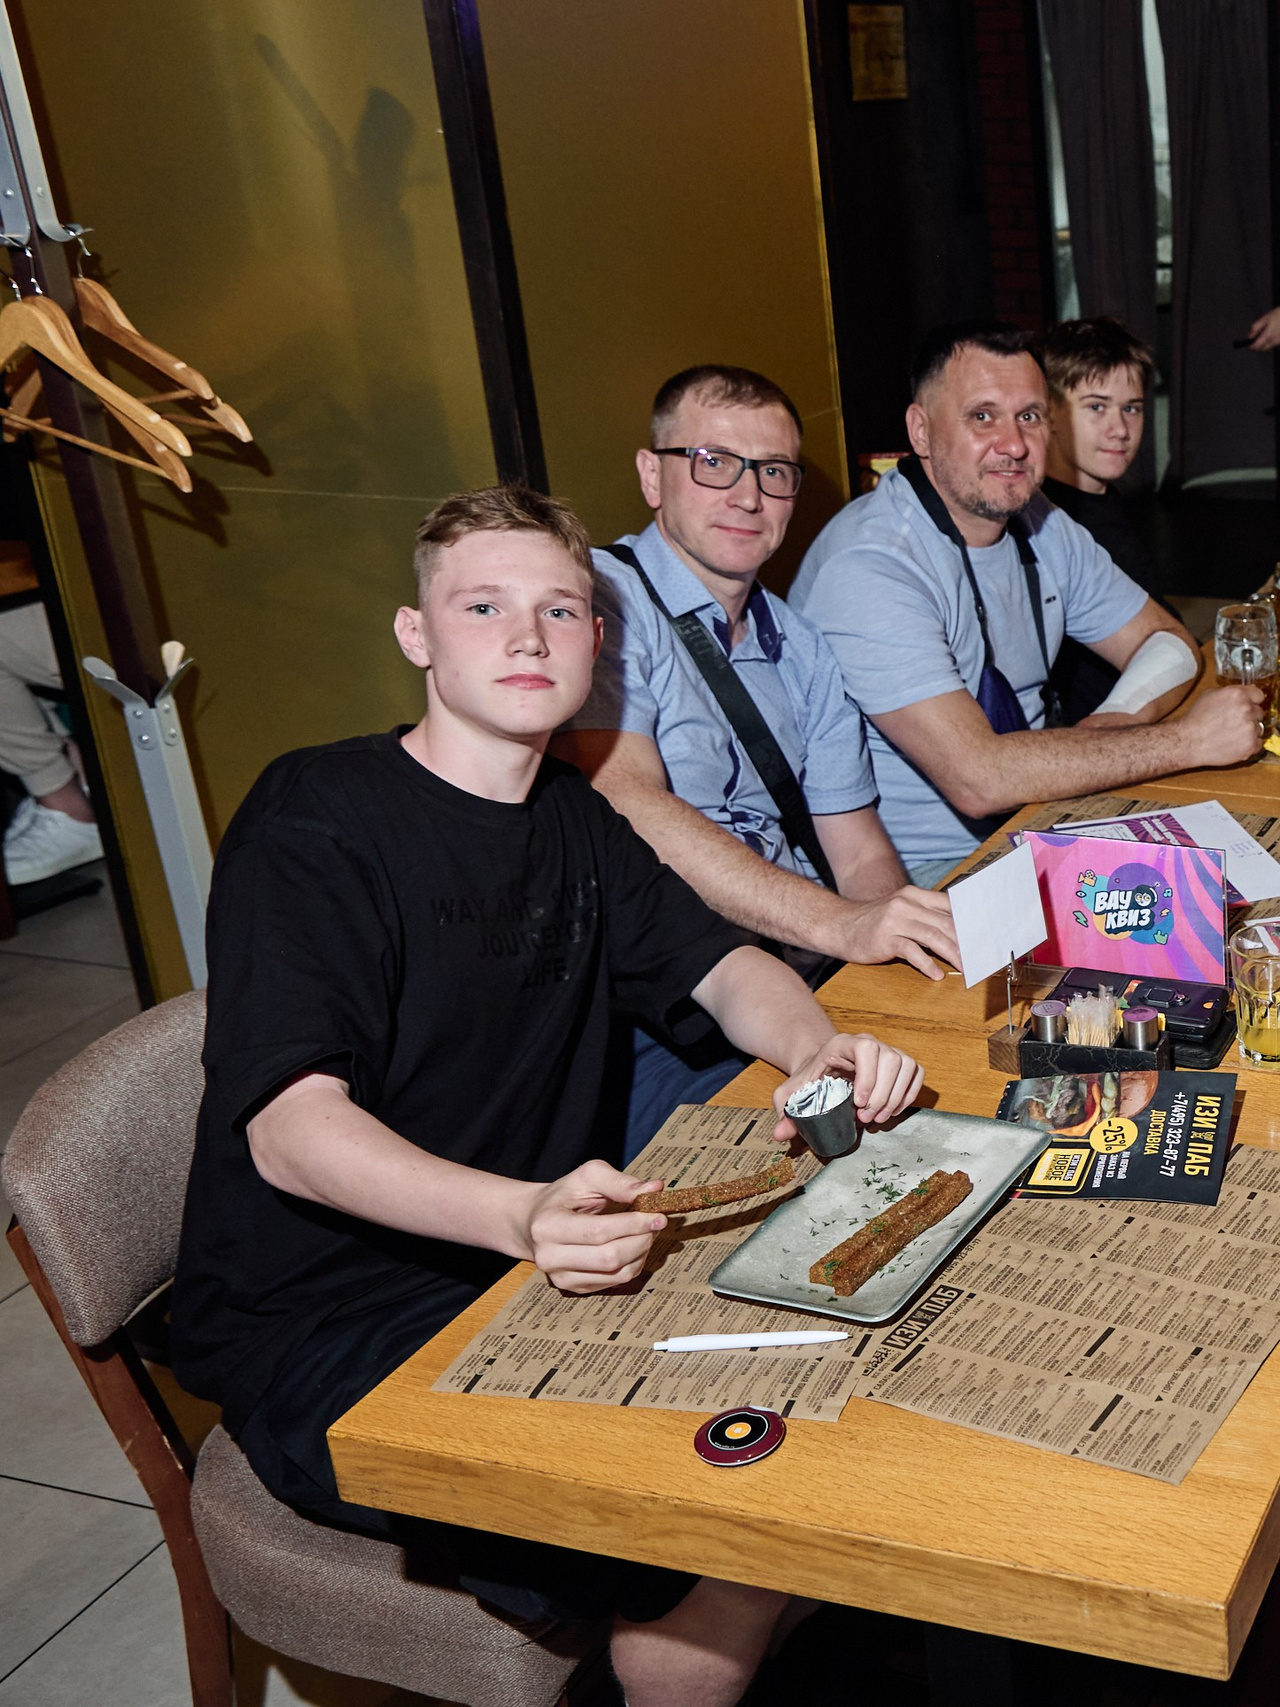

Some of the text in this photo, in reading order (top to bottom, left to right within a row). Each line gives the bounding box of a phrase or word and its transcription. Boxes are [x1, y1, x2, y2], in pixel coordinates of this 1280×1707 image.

[1094, 890, 1133, 912] ВАУ
[1104, 907, 1152, 932] КВИЗ
[1102, 1120, 1126, 1150] -25%
[1143, 1109, 1166, 1155] ДОСТАВКА
[1158, 1091, 1187, 1177] +7(495) 323-87-77
[1183, 1094, 1221, 1176] ИЗИ ПАБ
[1049, 1154, 1069, 1180] НОВОЕ
[1091, 1154, 1107, 1188] ПРИЛОЖЕНИЯ
[1106, 1154, 1118, 1169] ЗАКАЗ
[1116, 1158, 1128, 1179] ПЕРВЫЙ
[884, 1287, 961, 1347] ИЗИ ПАБ
[927, 1298, 972, 1337] ХОЛОДНЫЕ ЗАКУСКИ
[490, 1341, 510, 1357] СОУСЫ
[553, 1347, 575, 1367] ГАРНИРЫ
[642, 1355, 663, 1374] ДЕСЕРТЫ
[800, 1361, 820, 1382] РИМСКАЯ
[1070, 1358, 1087, 1371] ПАСТА
[871, 1372, 895, 1390] САЛАТЫ
[1160, 1372, 1182, 1393] ГОРЯЧИЕ
[1075, 1432, 1093, 1447] СУПЫ
